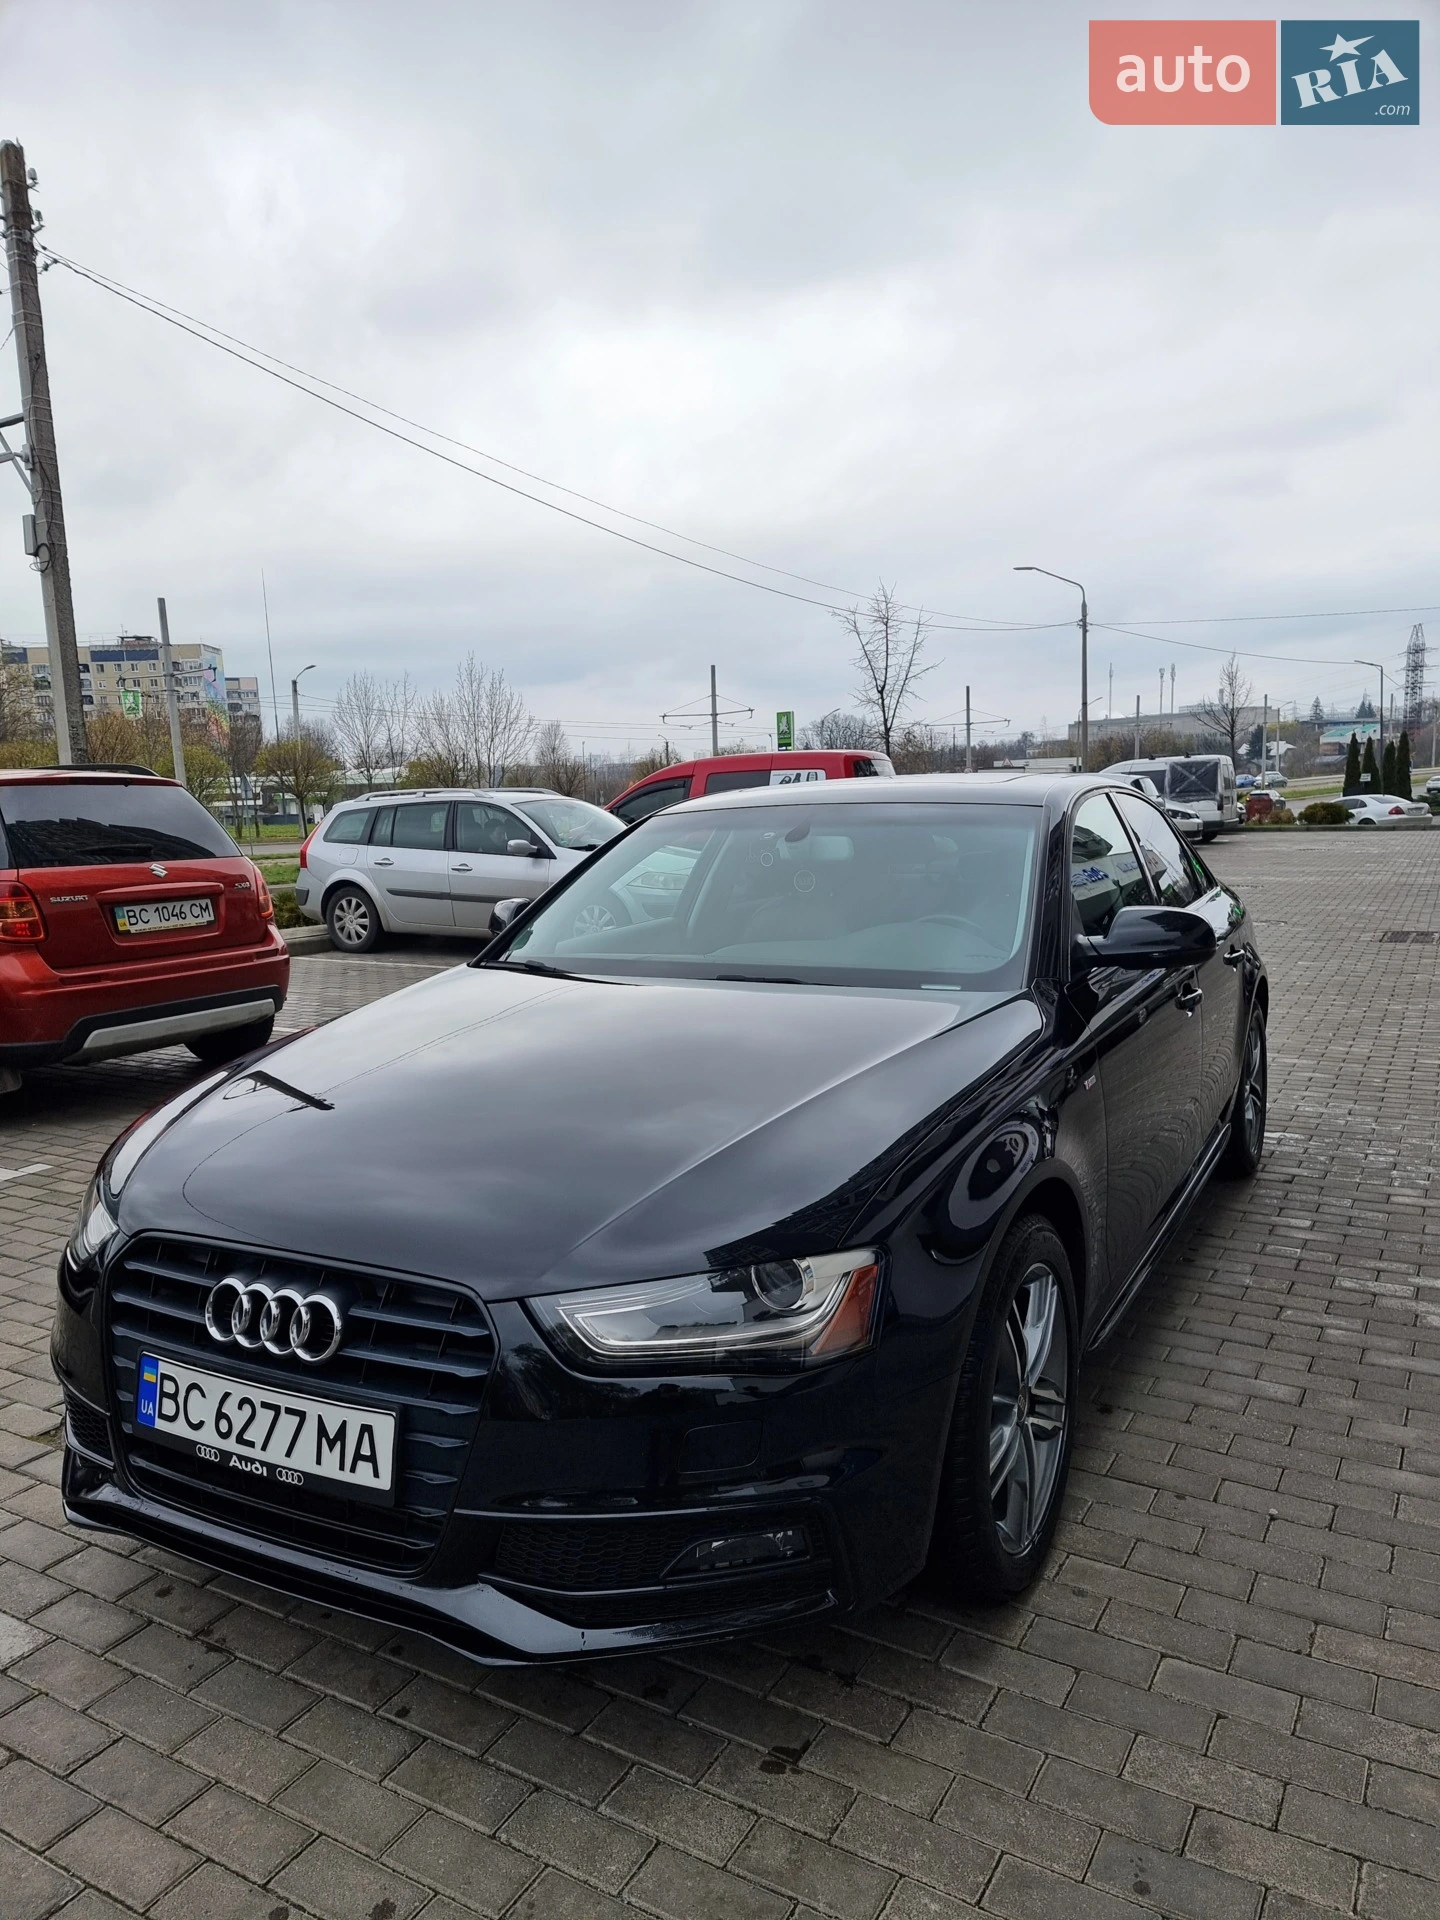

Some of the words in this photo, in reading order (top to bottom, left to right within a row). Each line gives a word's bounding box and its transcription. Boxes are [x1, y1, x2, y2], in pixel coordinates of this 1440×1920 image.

[49, 894, 89, 903] SUZUKI
[126, 908, 150, 926] BC
[154, 904, 187, 922] 1046
[189, 902, 211, 919] CM
[141, 1399, 154, 1417] UA
[157, 1371, 207, 1431] BC
[214, 1390, 307, 1459] 6277
[315, 1412, 380, 1479] MA
[229, 1454, 268, 1477] Audi
